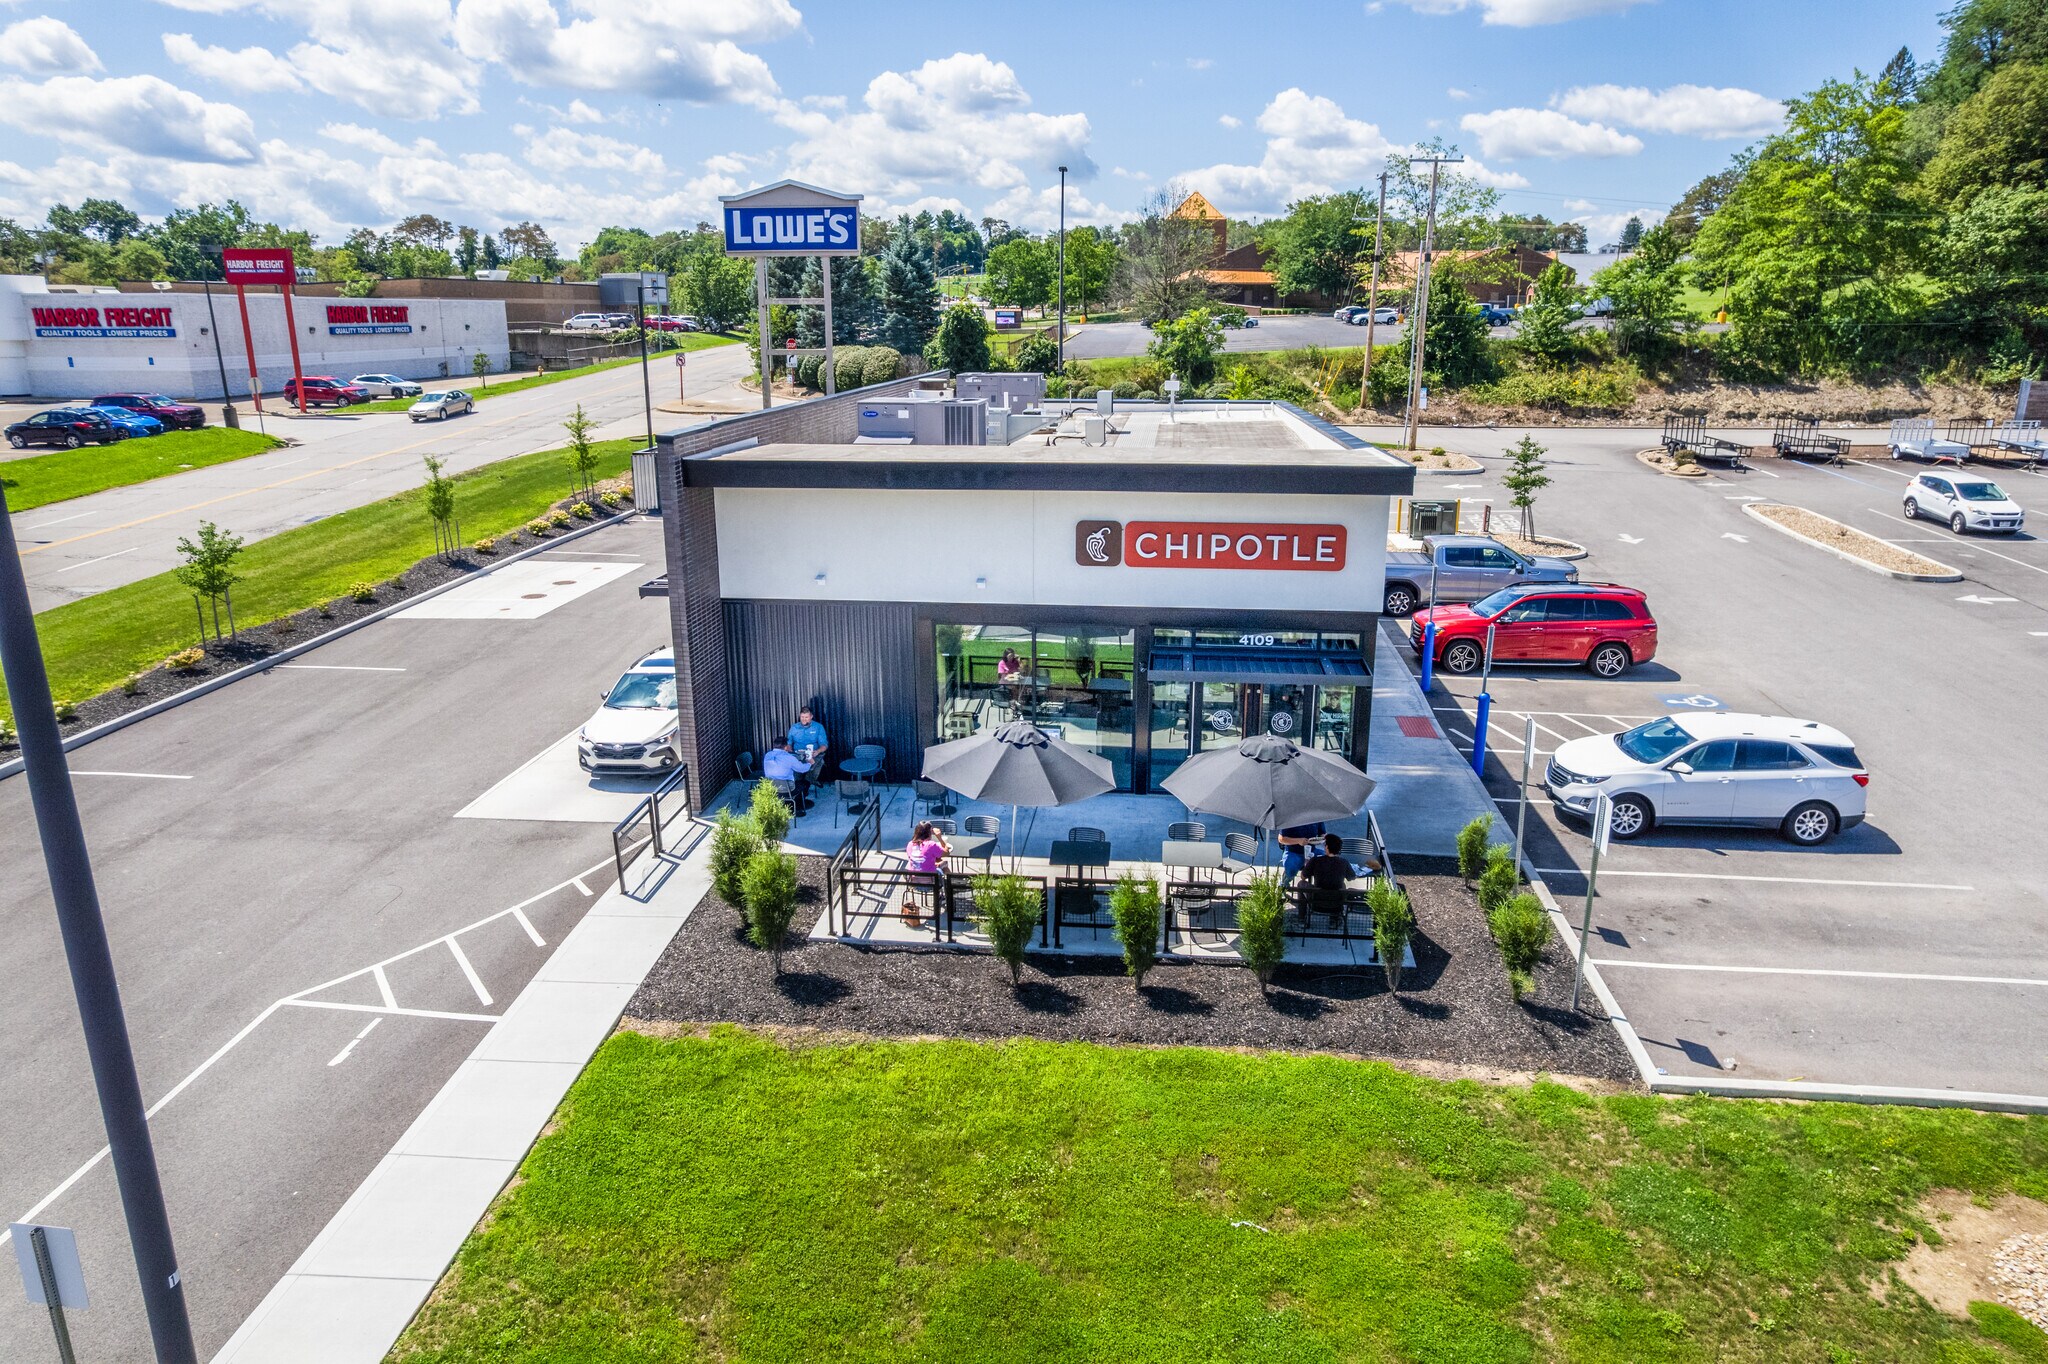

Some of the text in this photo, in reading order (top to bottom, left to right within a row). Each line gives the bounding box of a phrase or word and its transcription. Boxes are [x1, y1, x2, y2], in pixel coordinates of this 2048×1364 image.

[732, 209, 849, 244] LOWE'S
[226, 260, 284, 269] HARBOR FREIGHT
[31, 308, 172, 327] HARBOR FREIGHT
[326, 305, 409, 323] HARBOR FREIGHT
[1135, 532, 1337, 562] CHIPOTLE
[1239, 634, 1274, 646] 4109
